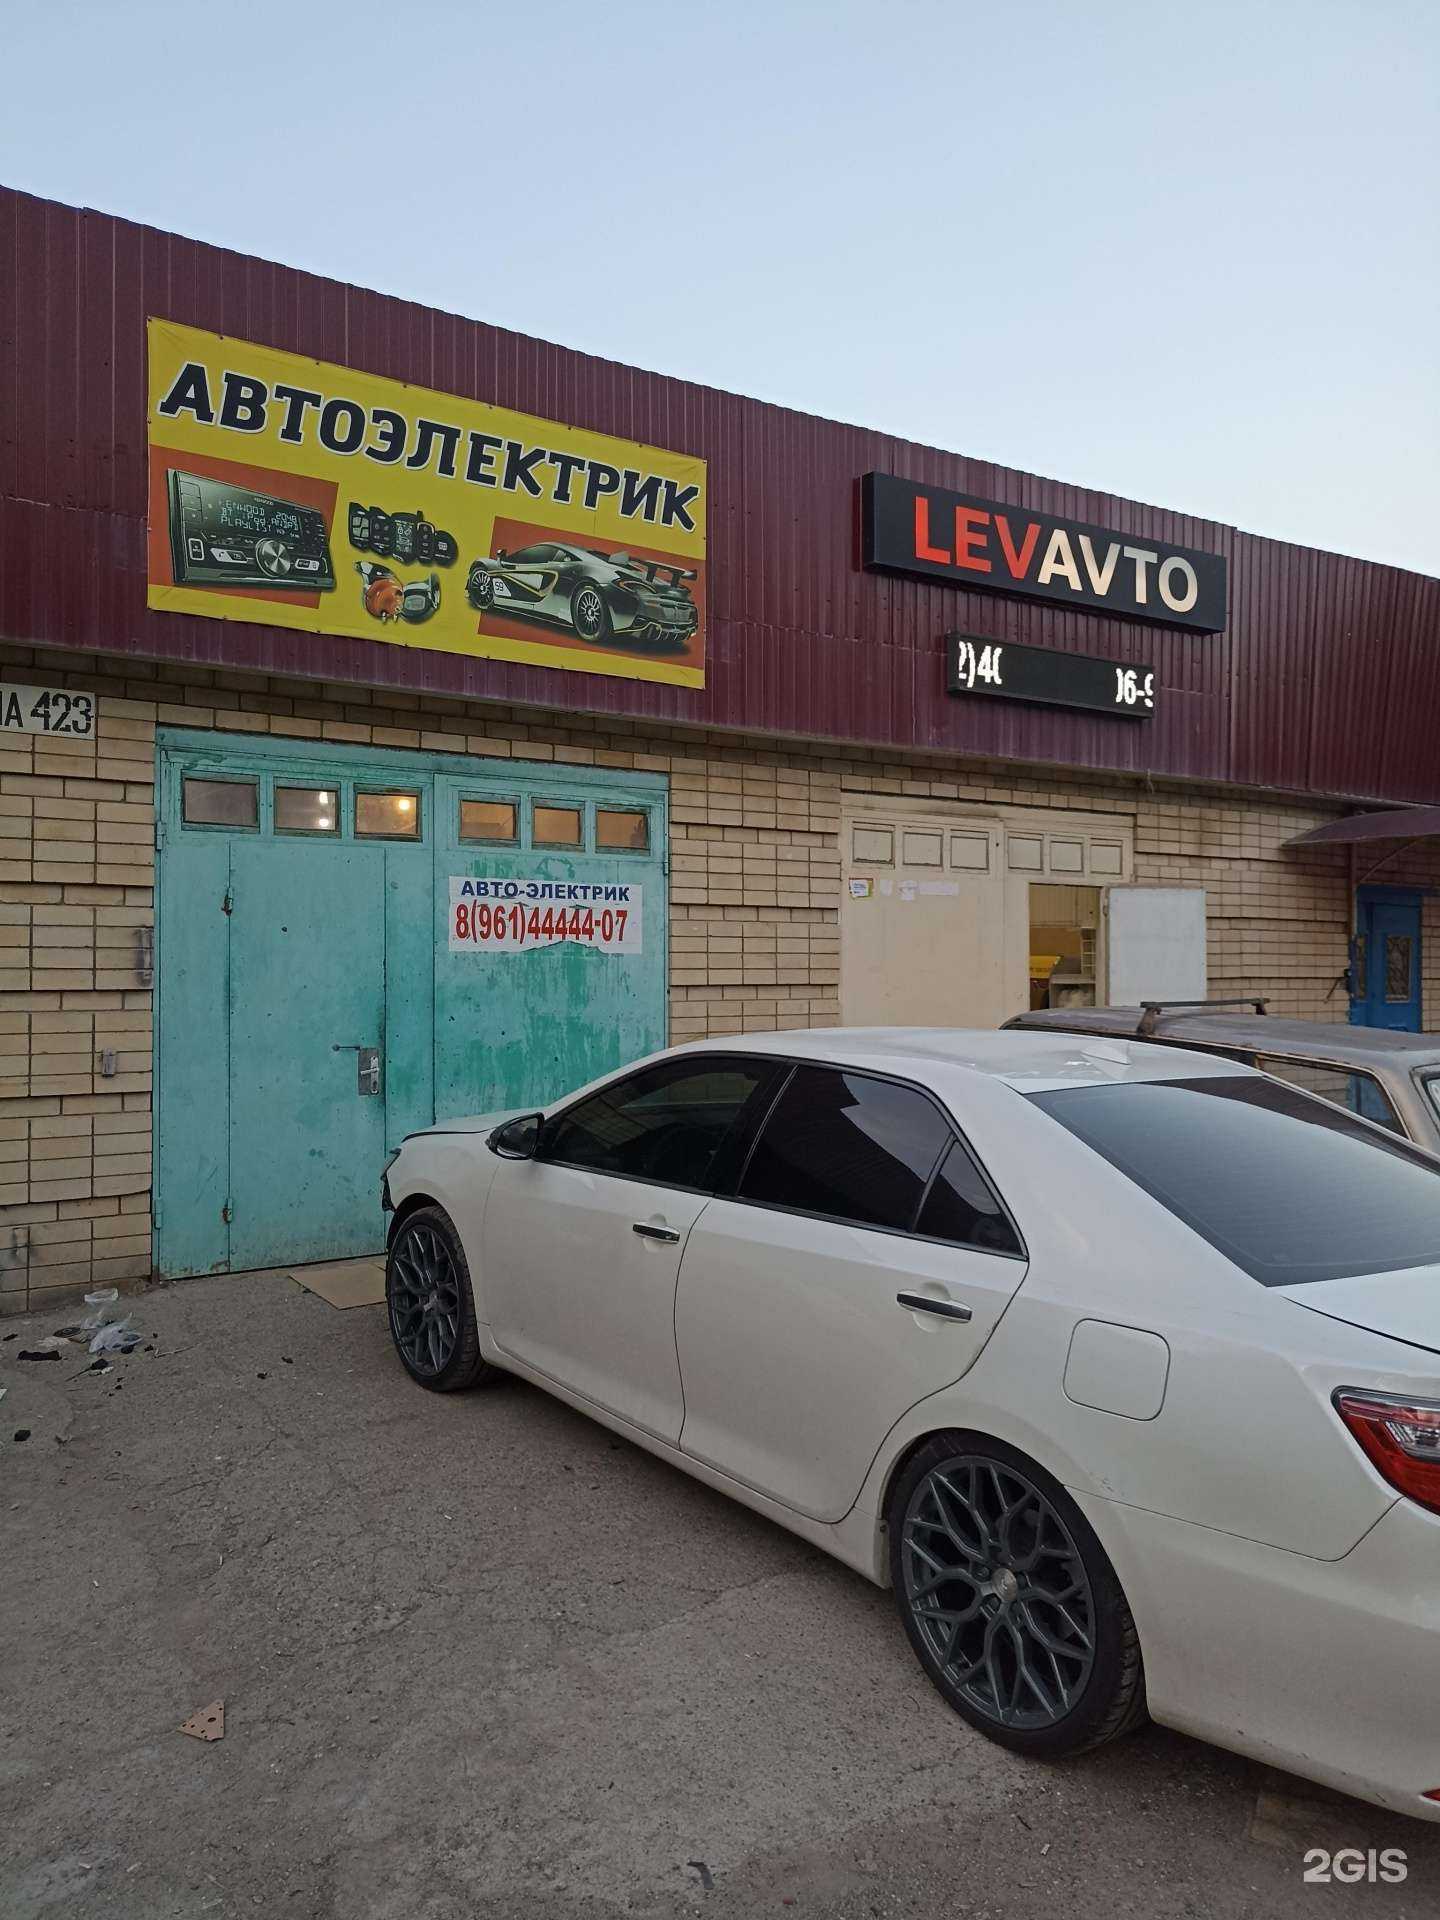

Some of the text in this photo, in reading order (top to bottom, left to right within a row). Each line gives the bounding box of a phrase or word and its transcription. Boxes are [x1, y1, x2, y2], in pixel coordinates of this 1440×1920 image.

[158, 361, 699, 532] АВТОЭЛЕКТРИК
[915, 495, 1198, 613] LEVAVTO
[0, 690, 93, 734] А 423
[461, 880, 630, 902] АВТО-ЭЛЕКТРИК
[456, 899, 628, 944] 8(961)44444-07
